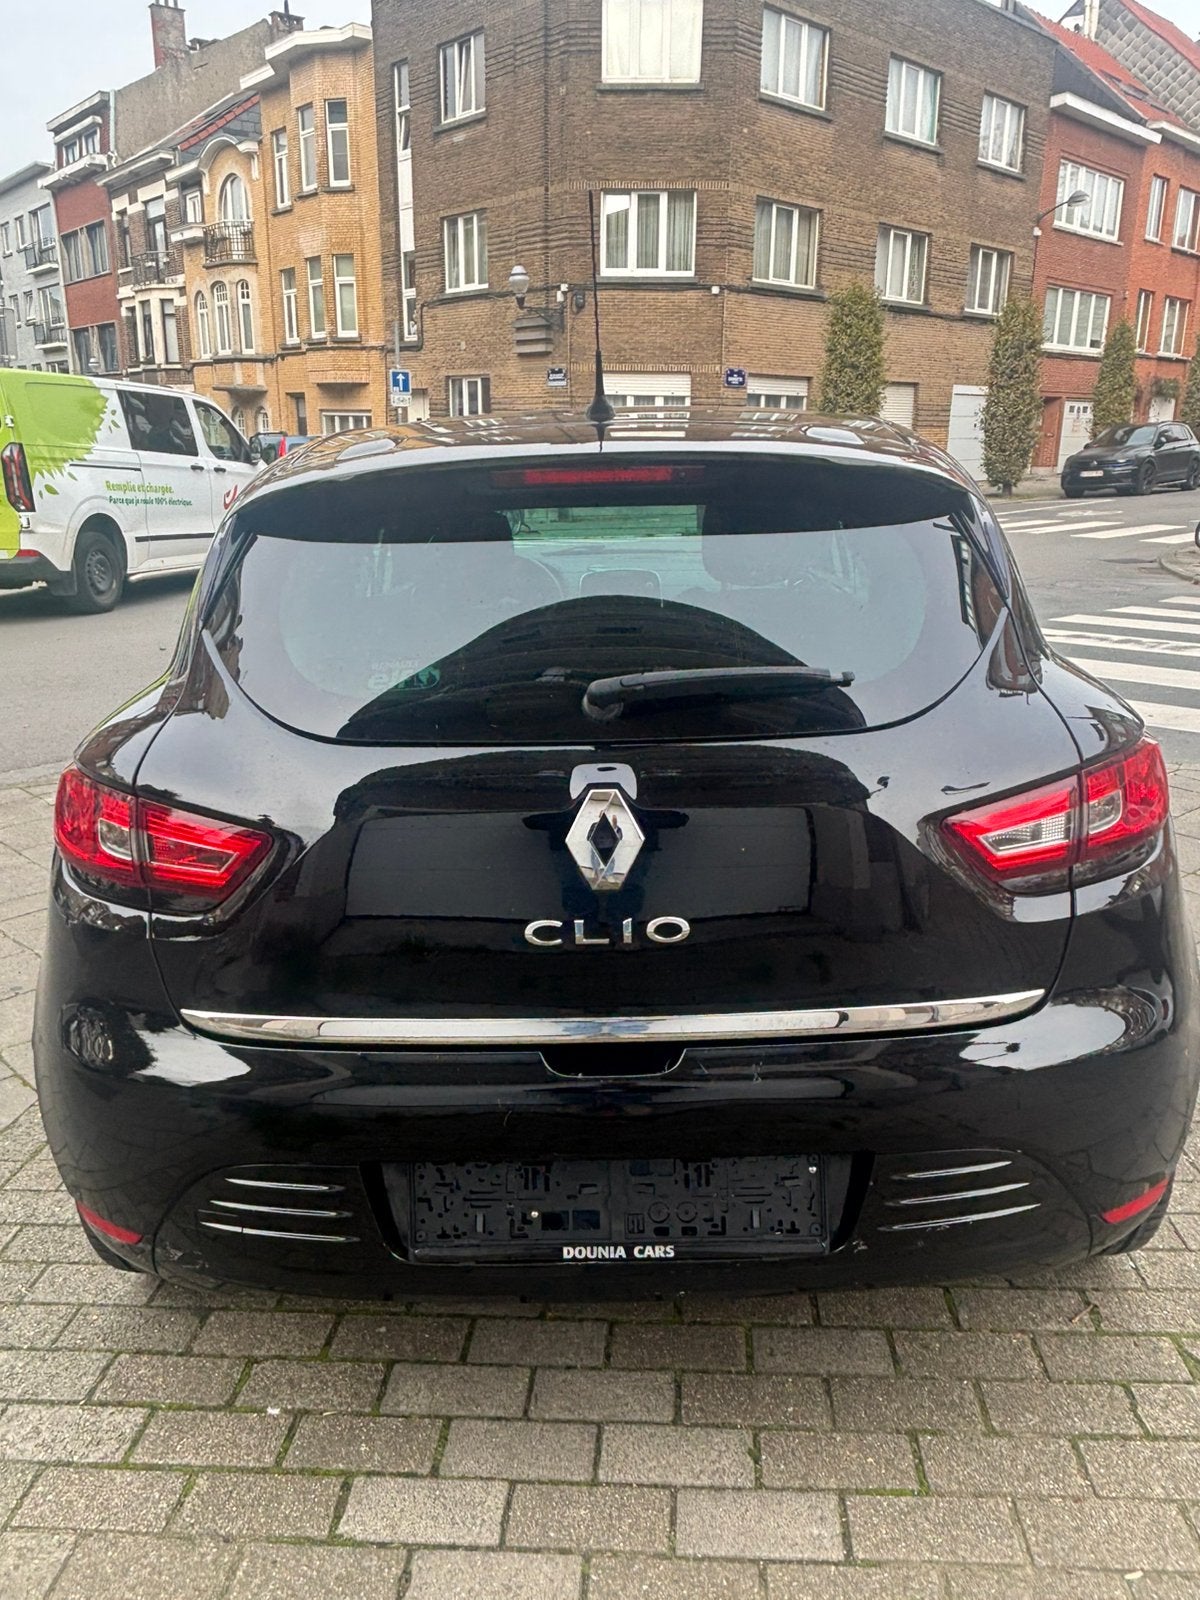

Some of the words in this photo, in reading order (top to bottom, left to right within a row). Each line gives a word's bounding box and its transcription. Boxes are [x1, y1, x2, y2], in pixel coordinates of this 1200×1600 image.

[105, 480, 136, 494] Remplie
[137, 484, 145, 493] et
[109, 495, 124, 505] Parce
[125, 498, 134, 506] que
[140, 497, 154, 505] roule
[524, 916, 691, 946] CLIO
[562, 1245, 627, 1259] DOUNIA
[633, 1245, 675, 1258] CARS
